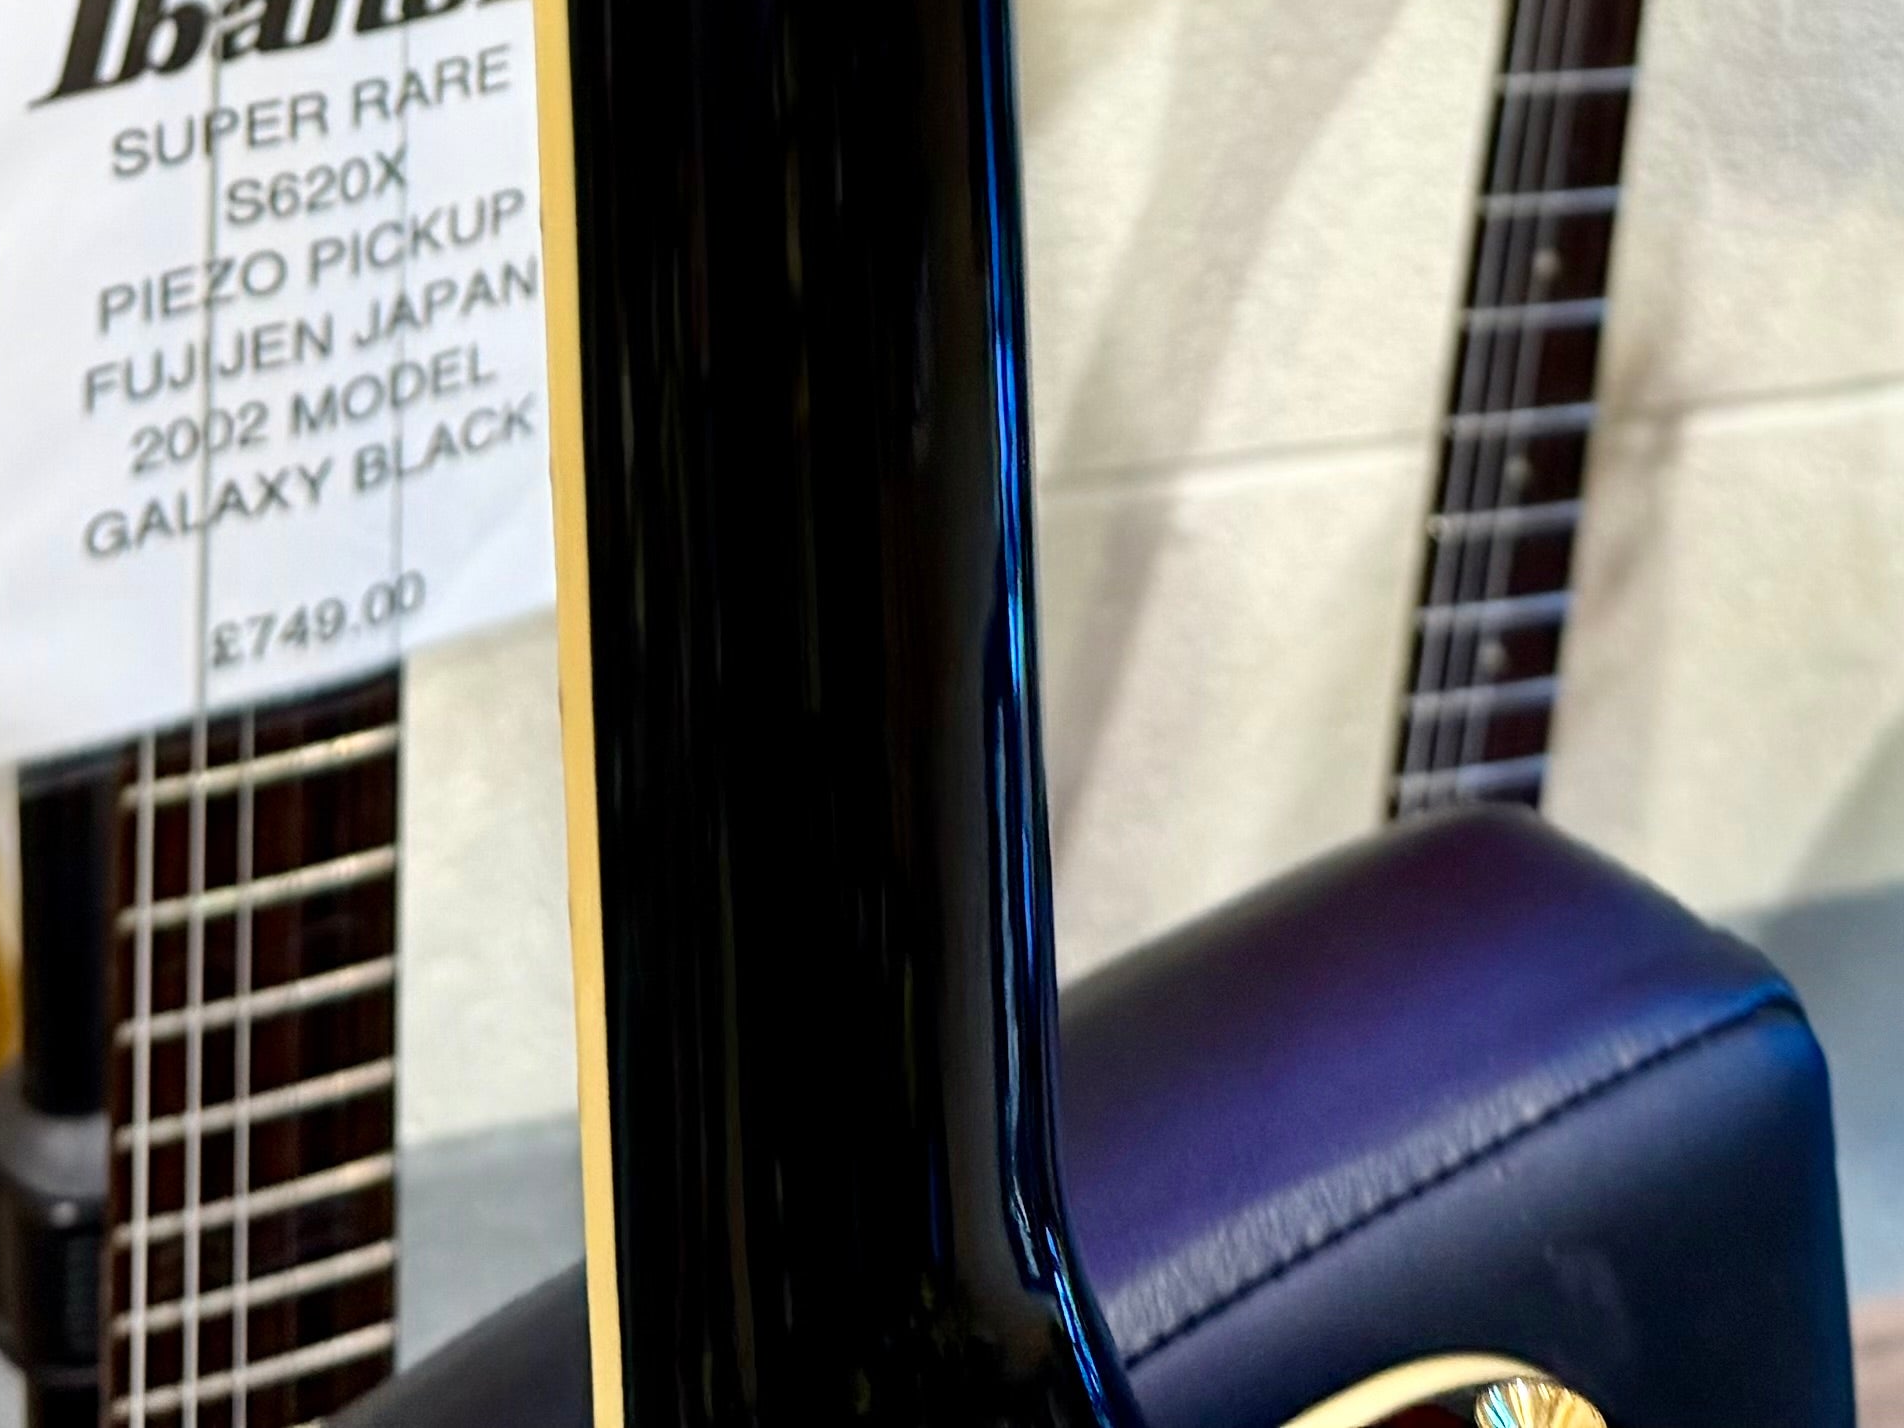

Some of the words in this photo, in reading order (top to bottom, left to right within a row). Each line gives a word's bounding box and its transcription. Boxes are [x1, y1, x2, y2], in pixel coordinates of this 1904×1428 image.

[110, 92, 329, 181] SUPER
[352, 44, 512, 128] RARE
[225, 149, 409, 228] S620X
[97, 249, 288, 336] PIEZO
[309, 187, 526, 289] PICKUP
[355, 255, 539, 350] JAPAN
[83, 457, 334, 561] GALAXY
[354, 392, 539, 496] BLACK
[130, 401, 268, 478] 2002
[291, 343, 495, 438] MODEL
[208, 569, 427, 670] £749.00
